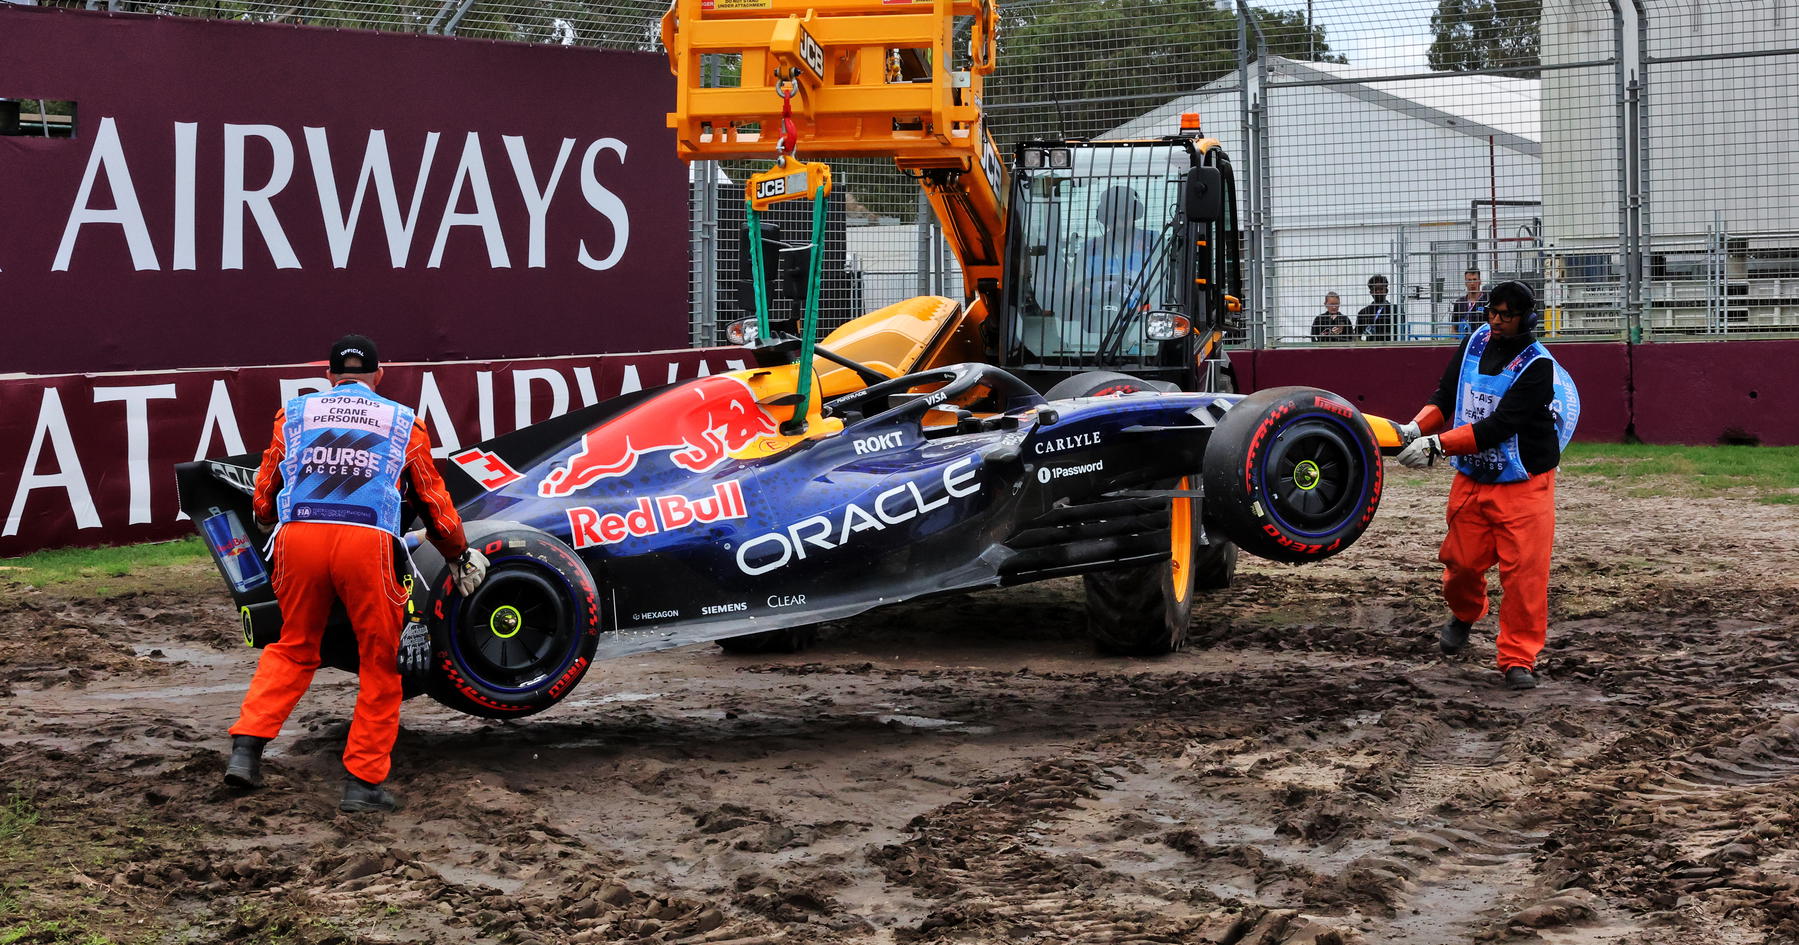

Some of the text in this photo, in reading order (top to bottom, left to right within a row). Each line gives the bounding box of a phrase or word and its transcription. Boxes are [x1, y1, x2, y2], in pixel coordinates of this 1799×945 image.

[800, 27, 824, 77] JCB
[51, 116, 629, 271] AIRWAYS
[757, 178, 785, 199] JCB
[340, 348, 365, 357] OFFICIAL
[320, 396, 381, 408] 0970-AUS
[925, 391, 948, 406] VISA
[1314, 396, 1353, 418] PIRELLI
[313, 415, 381, 428] PERSONNEL
[329, 407, 367, 416] CRANE
[852, 431, 904, 455] ROKT
[1035, 431, 1101, 454] CARLYLE
[1, 377, 333, 537] ATA
[302, 446, 382, 472] COURSE
[305, 465, 373, 478] ACCESS
[1052, 459, 1104, 479] 1Password
[297, 508, 311, 517] FIA
[566, 479, 748, 550] Red Bull
[736, 457, 982, 576] ORACLE
[1263, 524, 1323, 553] ZERO
[701, 602, 748, 615] SIEMENS
[767, 594, 806, 608] CLEAR
[641, 609, 679, 620] HEXAGON
[548, 657, 588, 699] PIRELLI
